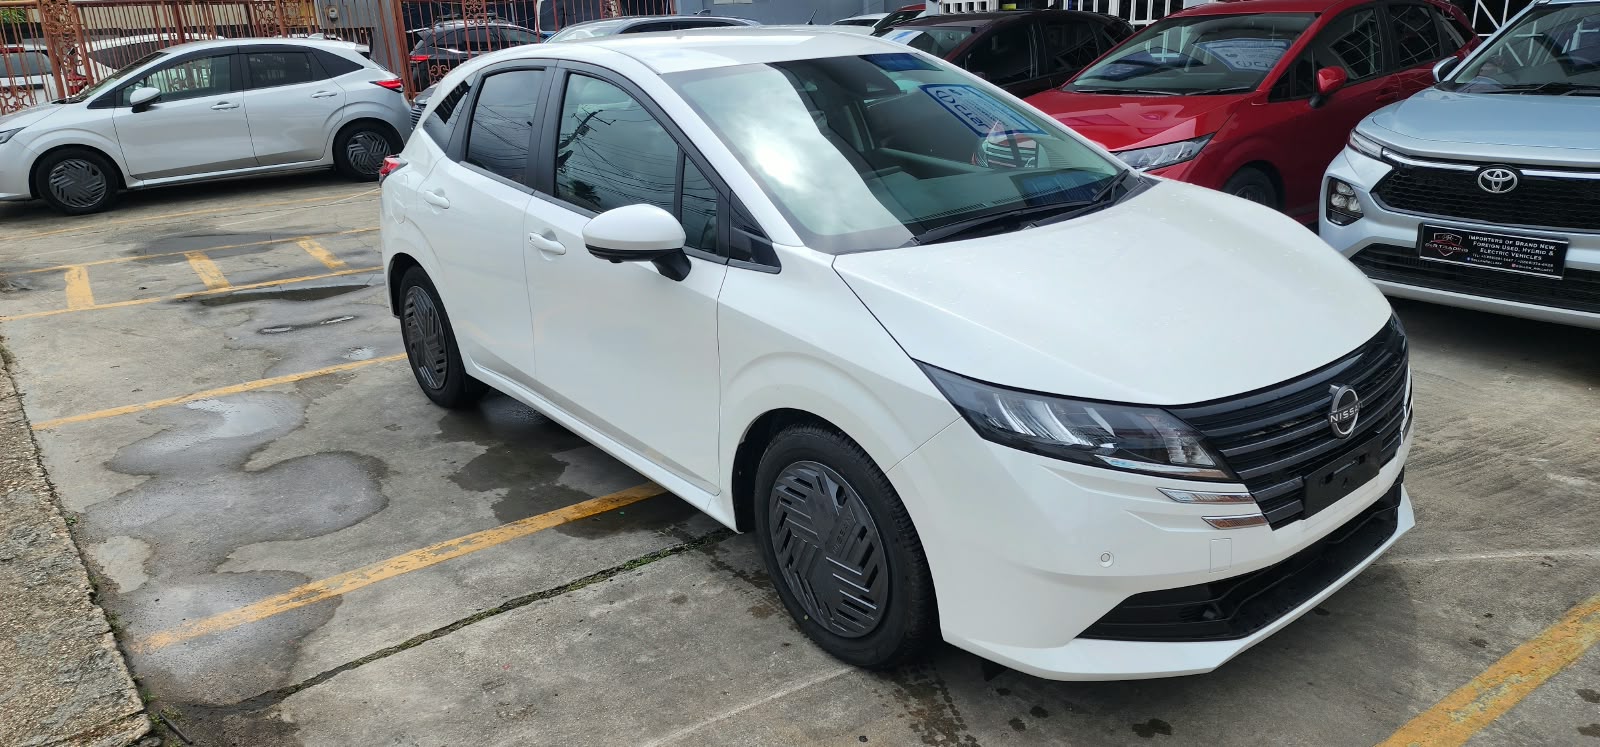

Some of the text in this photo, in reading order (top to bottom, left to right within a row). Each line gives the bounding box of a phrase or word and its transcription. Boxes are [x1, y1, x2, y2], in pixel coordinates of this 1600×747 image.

[1468, 235, 1503, 244] IMPORTERS
[1515, 240, 1538, 248] BRAND
[1472, 240, 1501, 249] FOREIGN
[1522, 247, 1547, 255] HYBRID
[1480, 247, 1510, 257] ELECTRIC
[1511, 252, 1542, 261] VEHICLES
